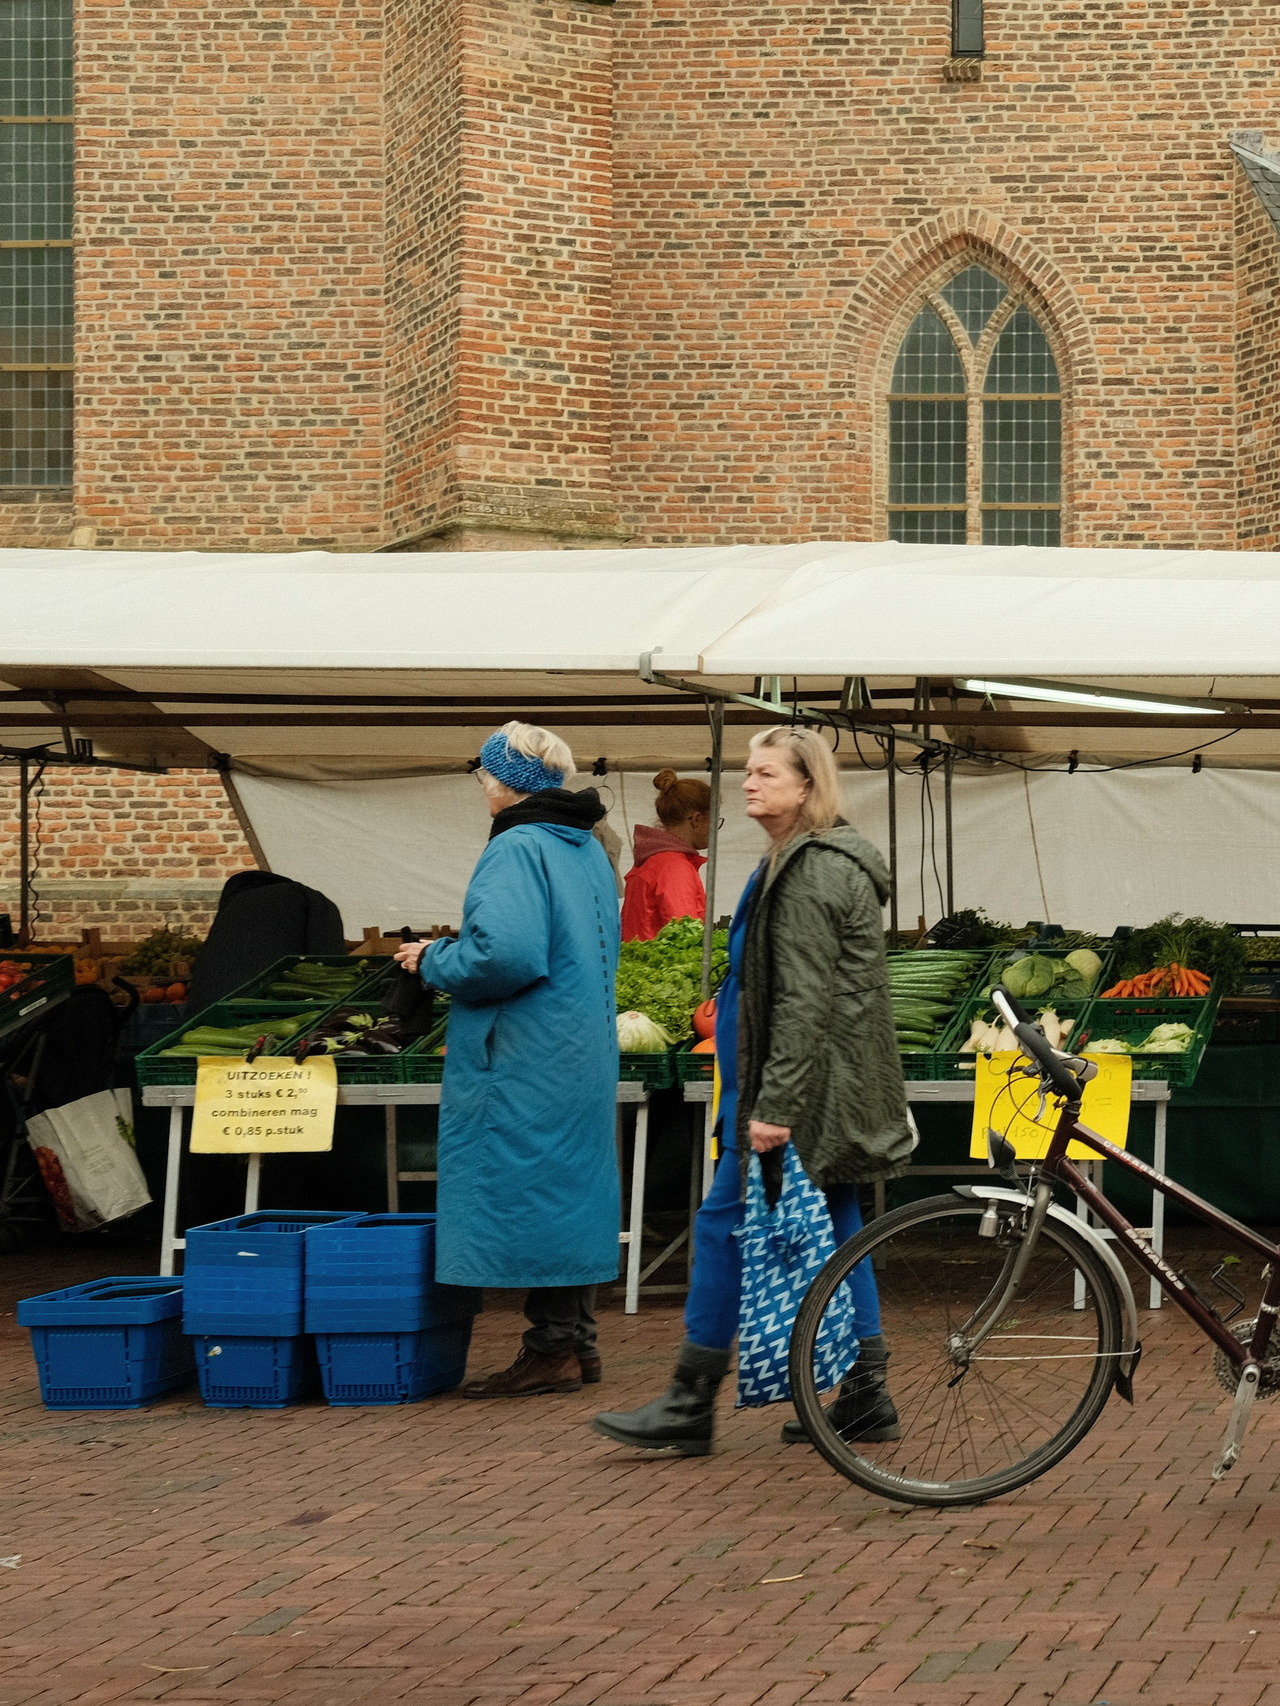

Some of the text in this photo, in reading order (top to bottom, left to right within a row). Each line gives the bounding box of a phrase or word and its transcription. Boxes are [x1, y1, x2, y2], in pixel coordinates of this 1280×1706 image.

[227, 1071, 303, 1081] UITZOEKEN
[225, 1089, 233, 1099] 3
[237, 1089, 272, 1099] stuks
[275, 1088, 283, 1098] €
[211, 1107, 318, 1118] combineren mag
[222, 1126, 231, 1136] €
[234, 1126, 262, 1138] 0,85
[1125, 1228, 1185, 1291] BATAVUS
